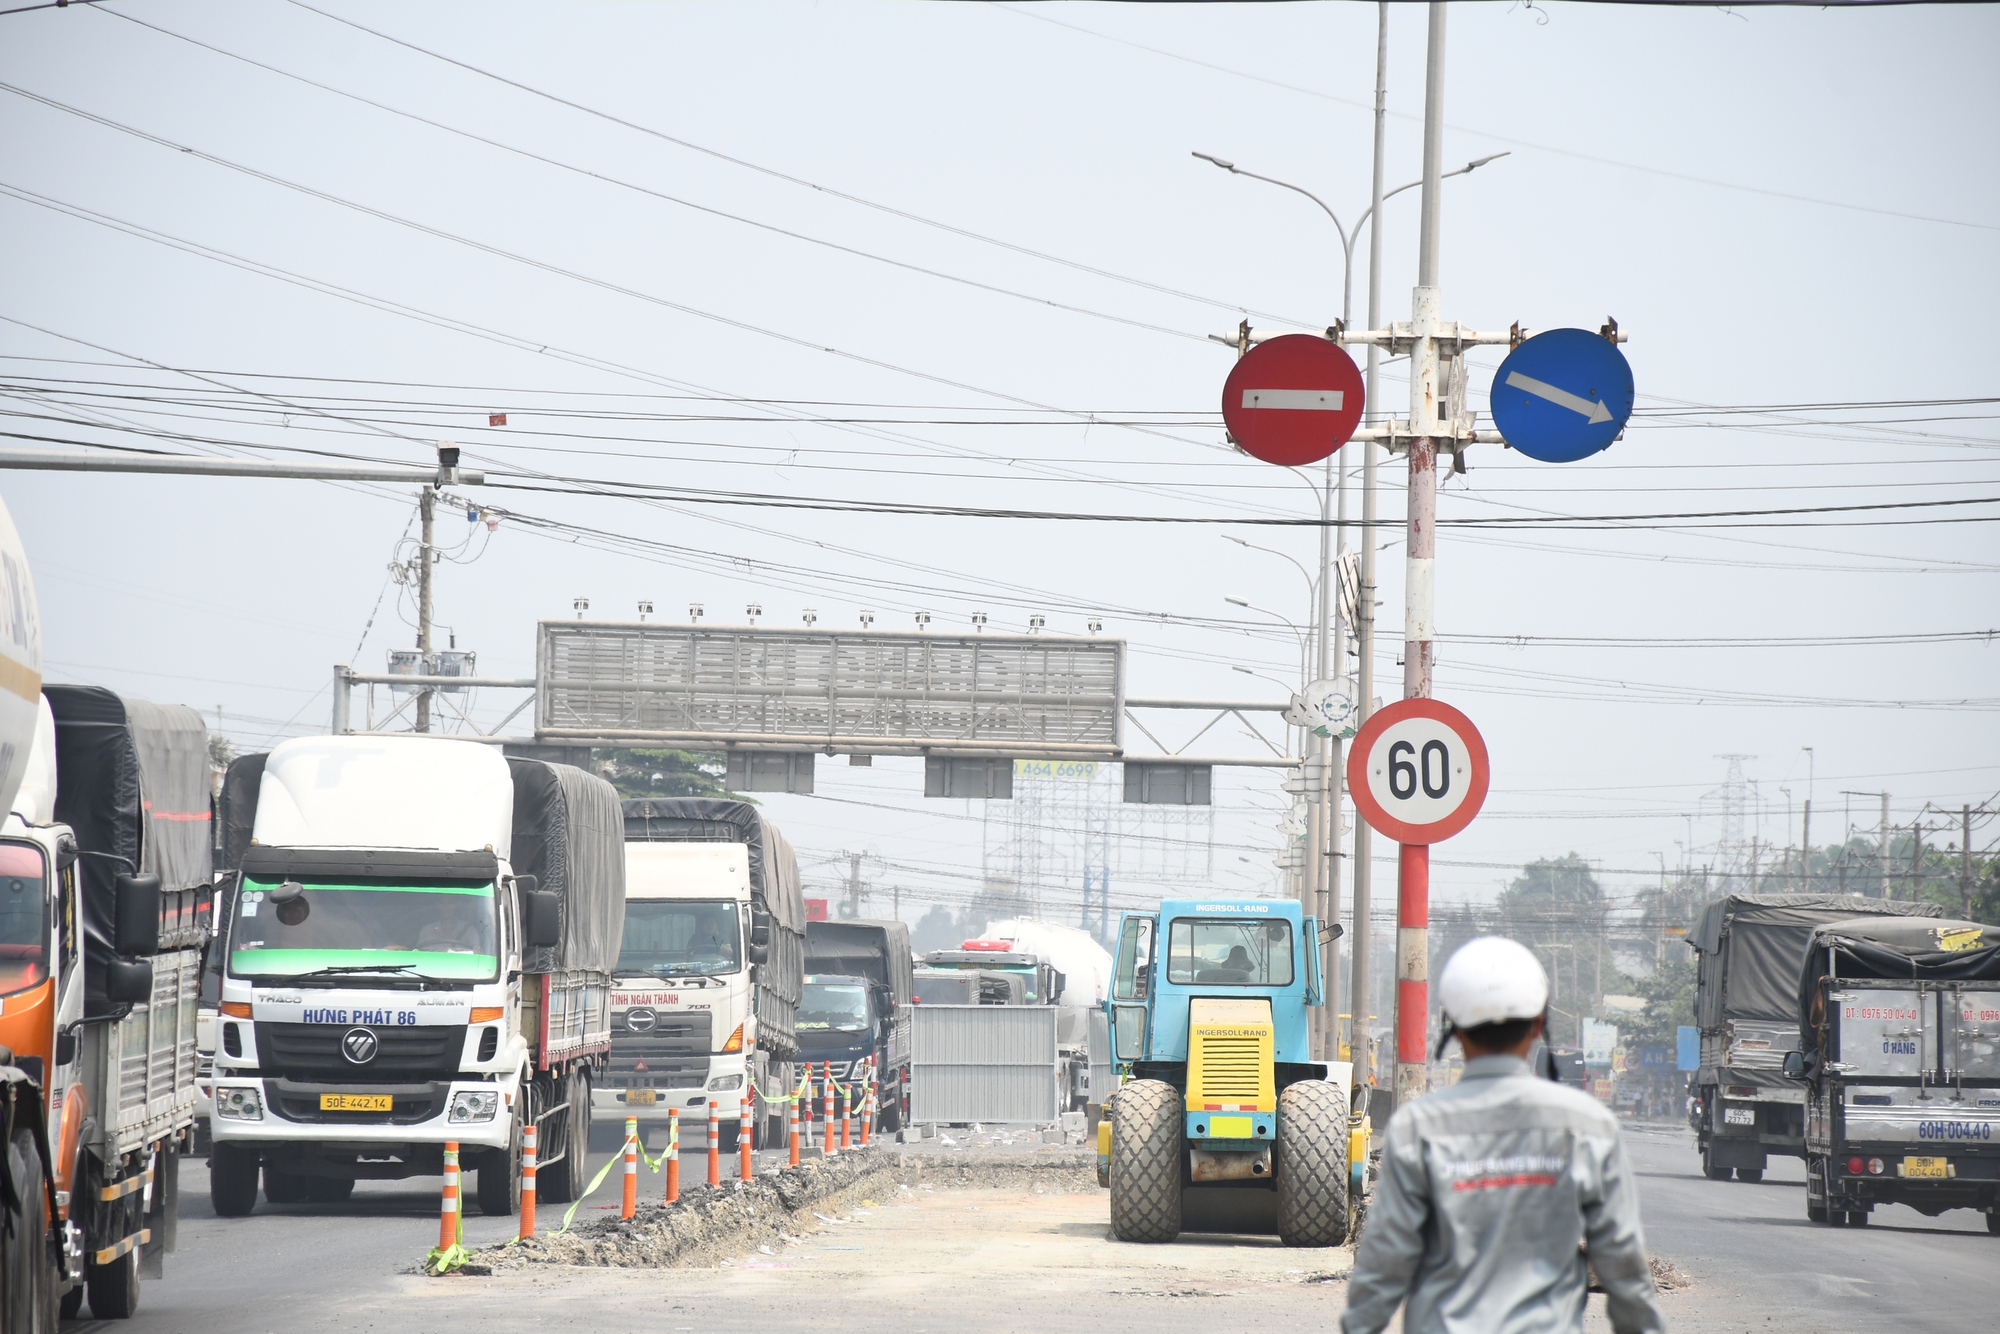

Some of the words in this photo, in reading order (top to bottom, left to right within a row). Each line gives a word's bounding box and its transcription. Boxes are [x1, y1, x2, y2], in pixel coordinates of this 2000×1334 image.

[1023, 762, 1052, 776] 464
[1057, 763, 1094, 777] 6699
[1389, 739, 1449, 800] 60
[1196, 904, 1242, 912] INGERSOLL
[258, 994, 302, 1004] THACO
[416, 997, 465, 1007] AUMAN
[630, 992, 652, 1005] NGÂN
[654, 991, 679, 1005] THÀNH
[303, 1008, 347, 1024] HƯNG
[352, 1008, 393, 1025] PHÁT
[397, 1011, 416, 1025] 86
[1861, 1008, 1881, 1019] 0976
[1883, 1008, 1893, 1020] 50
[1895, 1009, 1905, 1020] 04
[1907, 1009, 1917, 1020] 40
[1891, 1039, 1916, 1055] HÀNG
[326, 1097, 386, 1109] 50E-442.14
[1916, 1158, 1935, 1168] 60H
[1909, 1168, 1942, 1177] 004.40
